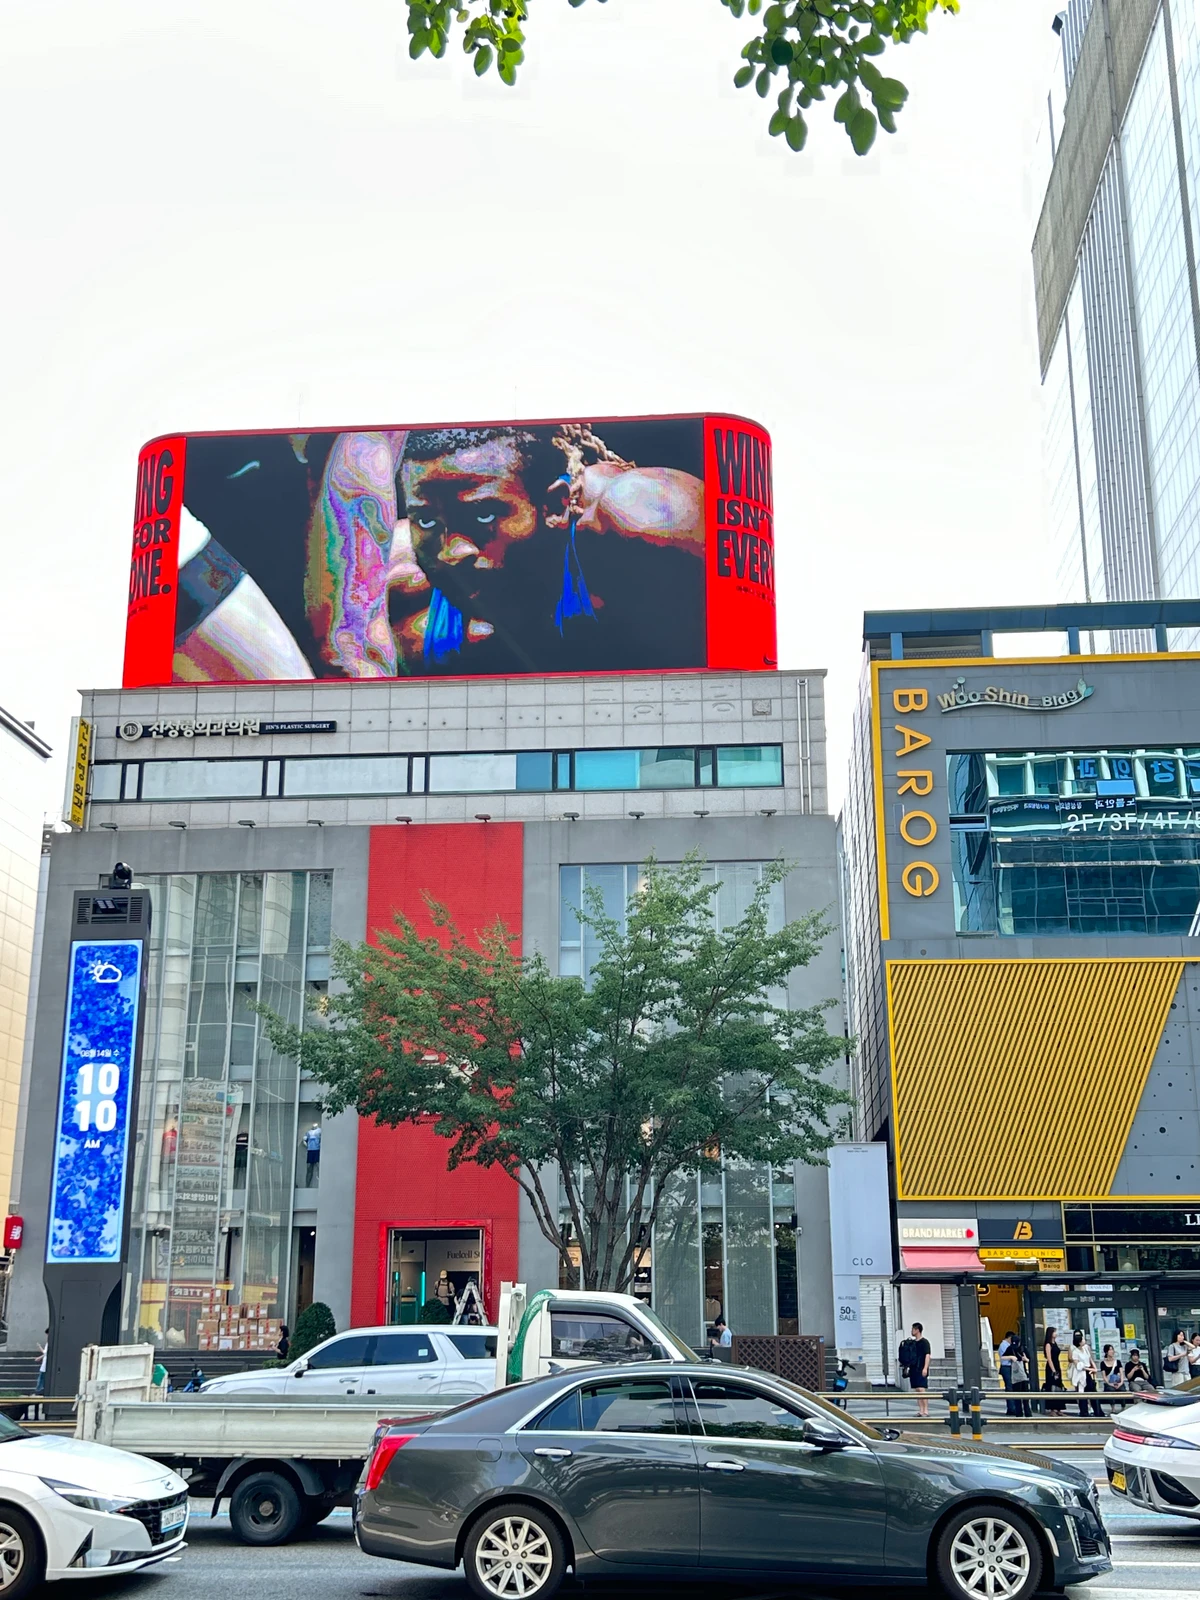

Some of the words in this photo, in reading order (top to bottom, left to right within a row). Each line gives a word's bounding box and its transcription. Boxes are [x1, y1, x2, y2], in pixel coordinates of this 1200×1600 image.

[1041, 690, 1079, 707] Bldg
[893, 688, 940, 897] BAROG
[78, 1063, 120, 1095] 10
[75, 1099, 117, 1132] 10
[84, 1139, 101, 1149] AM
[902, 1228, 933, 1239] BRAND
[933, 1228, 967, 1239] MARKET
[852, 1257, 873, 1266] CLO
[840, 1306, 856, 1315] 50%
